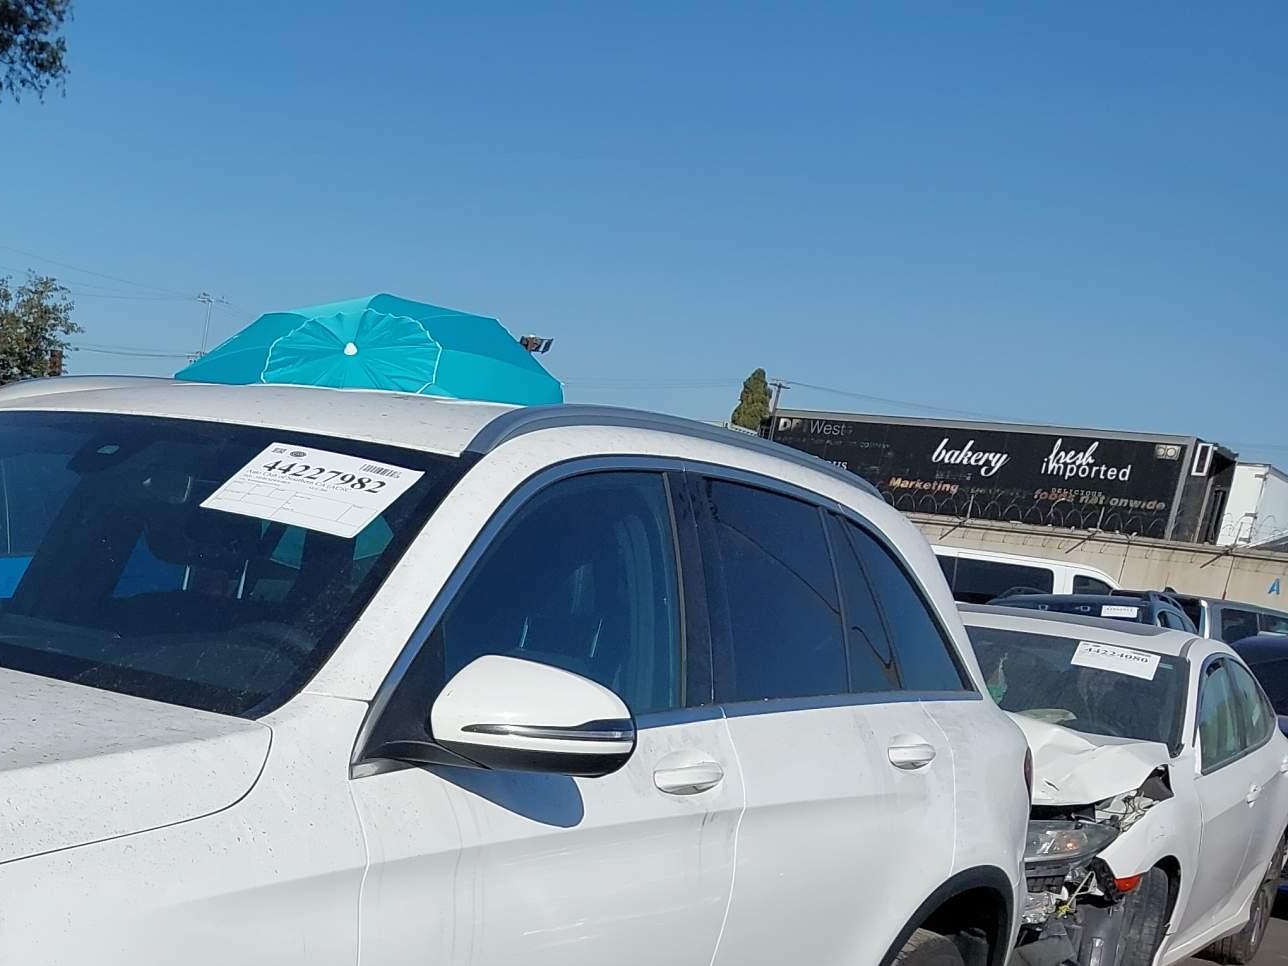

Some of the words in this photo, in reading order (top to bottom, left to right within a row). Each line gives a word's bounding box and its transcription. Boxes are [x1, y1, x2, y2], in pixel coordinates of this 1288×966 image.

[810, 419, 846, 436] West
[931, 438, 1011, 477] bakery
[1040, 457, 1132, 481] imported
[1048, 438, 1099, 472] fresh
[263, 460, 386, 494] 44227982
[888, 476, 960, 495] Marketing
